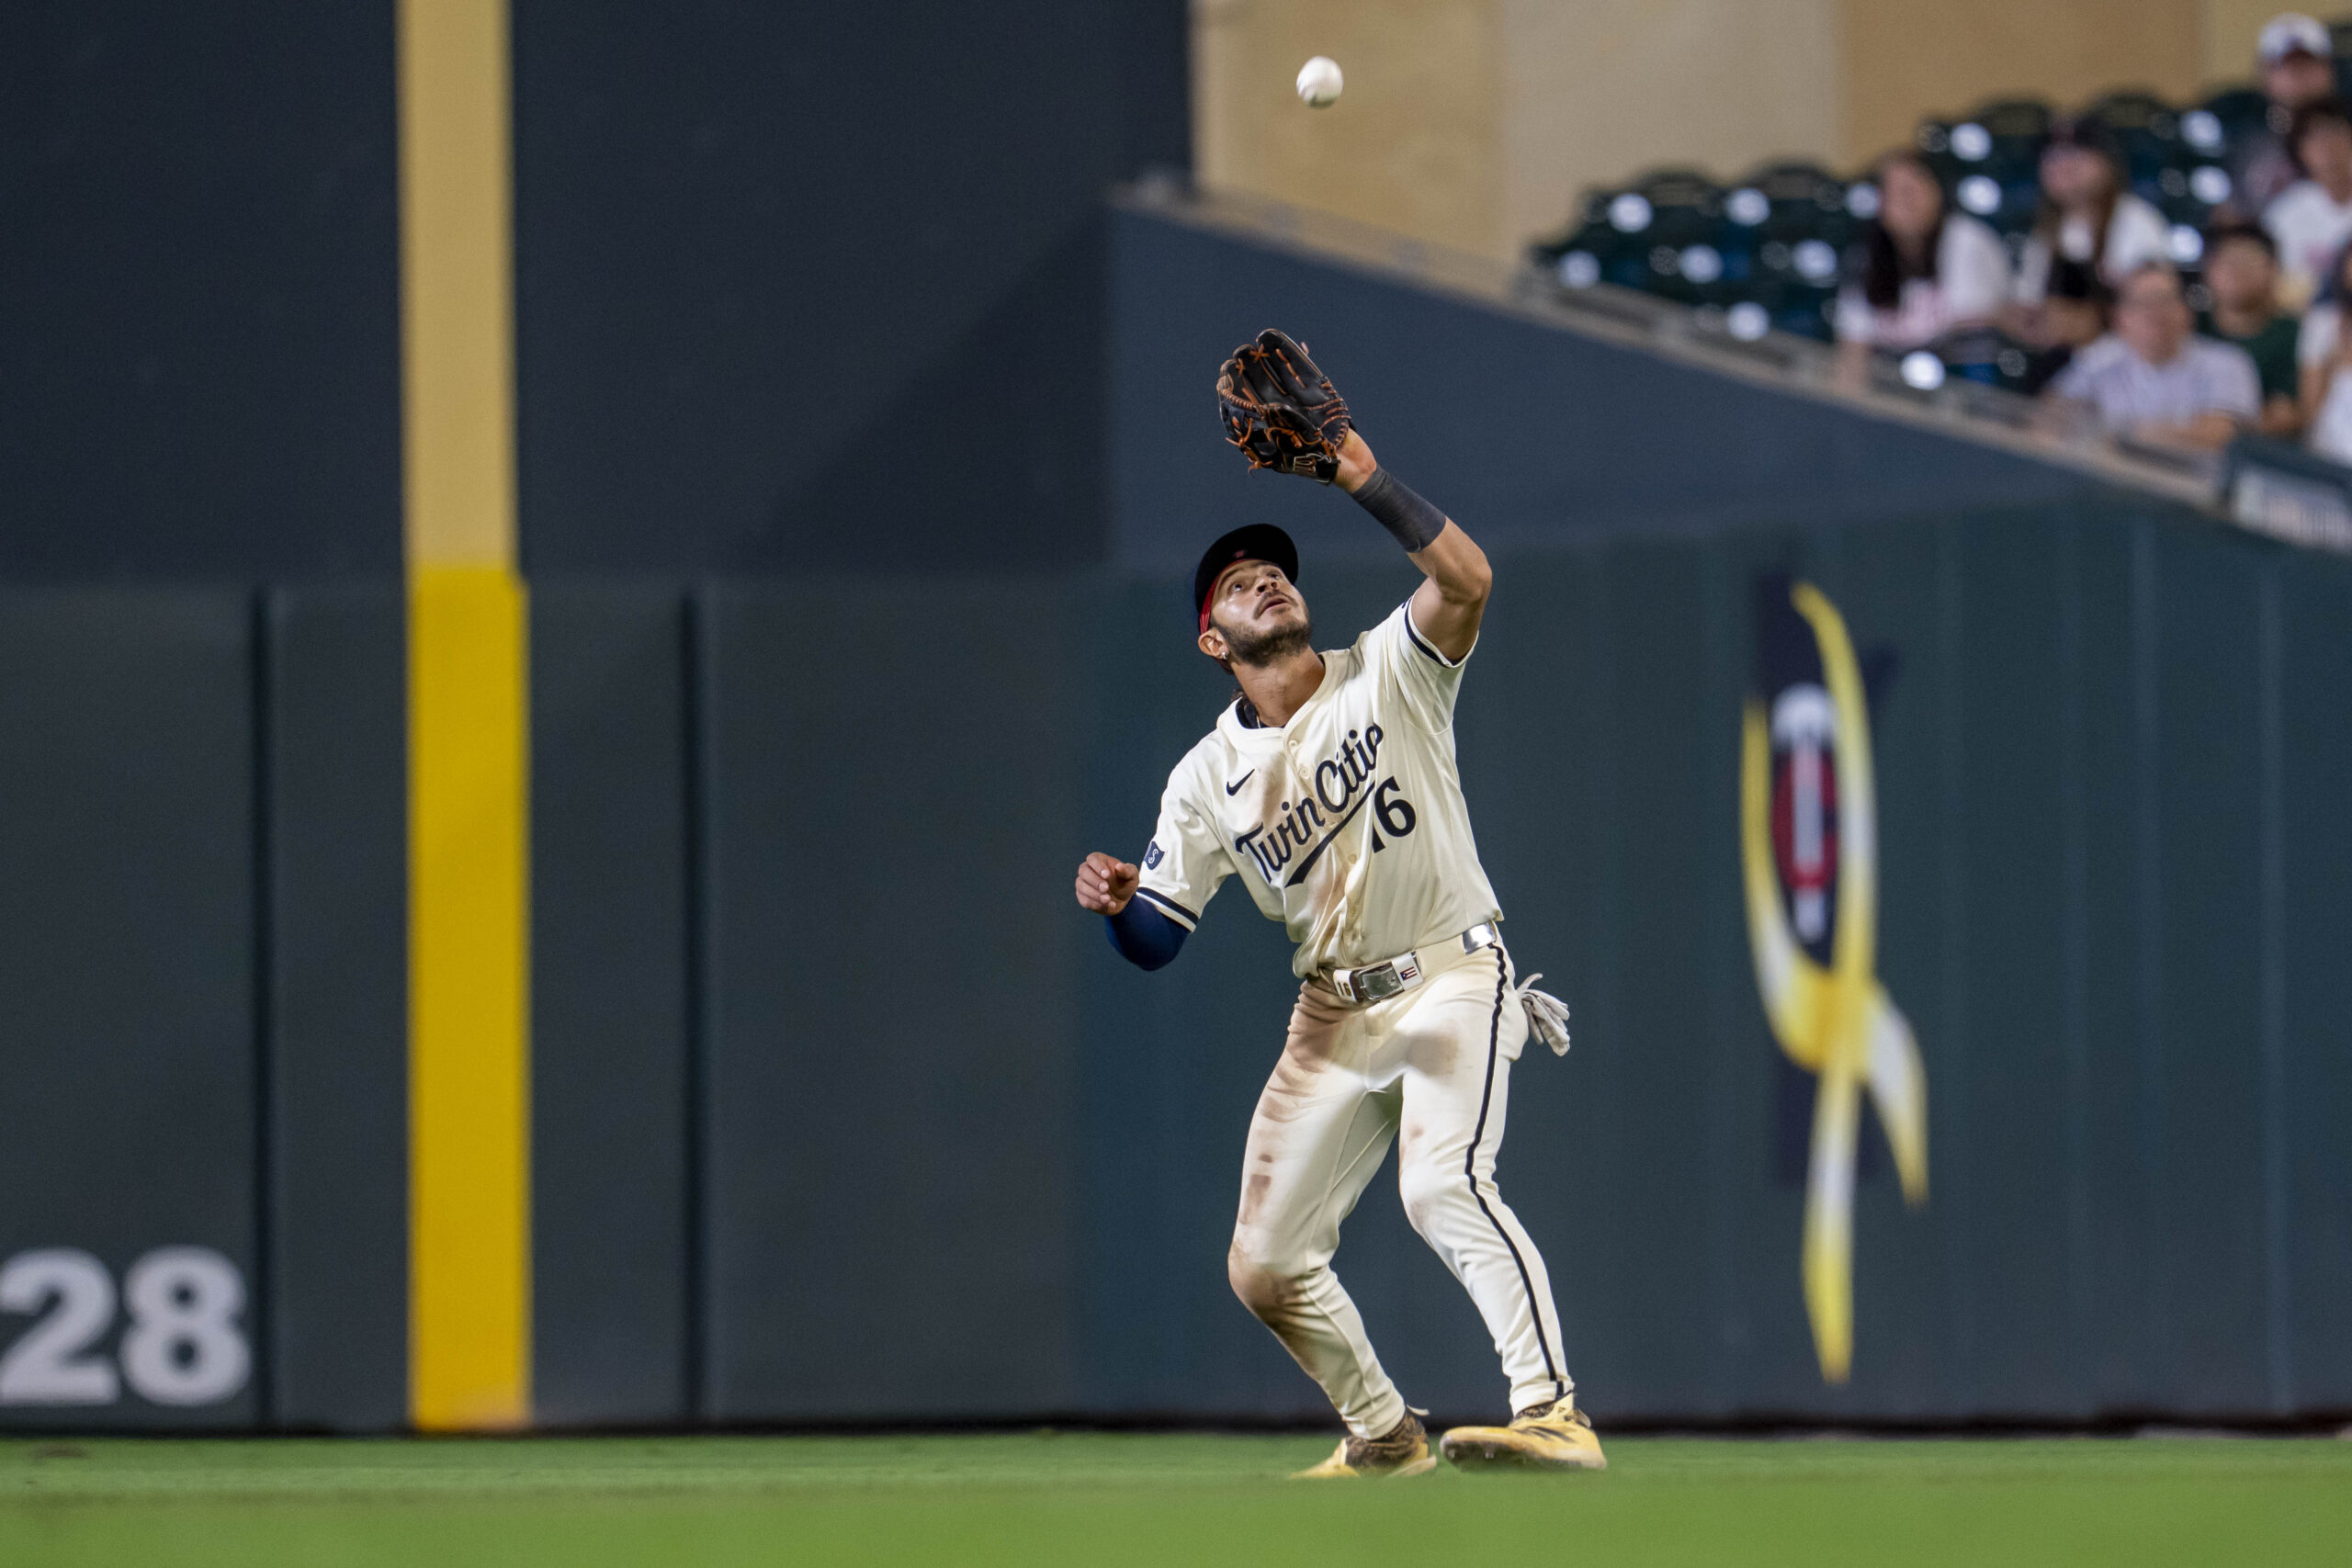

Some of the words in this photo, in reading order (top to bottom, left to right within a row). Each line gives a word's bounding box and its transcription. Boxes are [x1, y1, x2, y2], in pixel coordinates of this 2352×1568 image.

[1235, 796, 1326, 885] Twin
[1316, 722, 1384, 814] Citie
[1338, 981, 1352, 997] 16
[0, 1245, 252, 1407] 28
